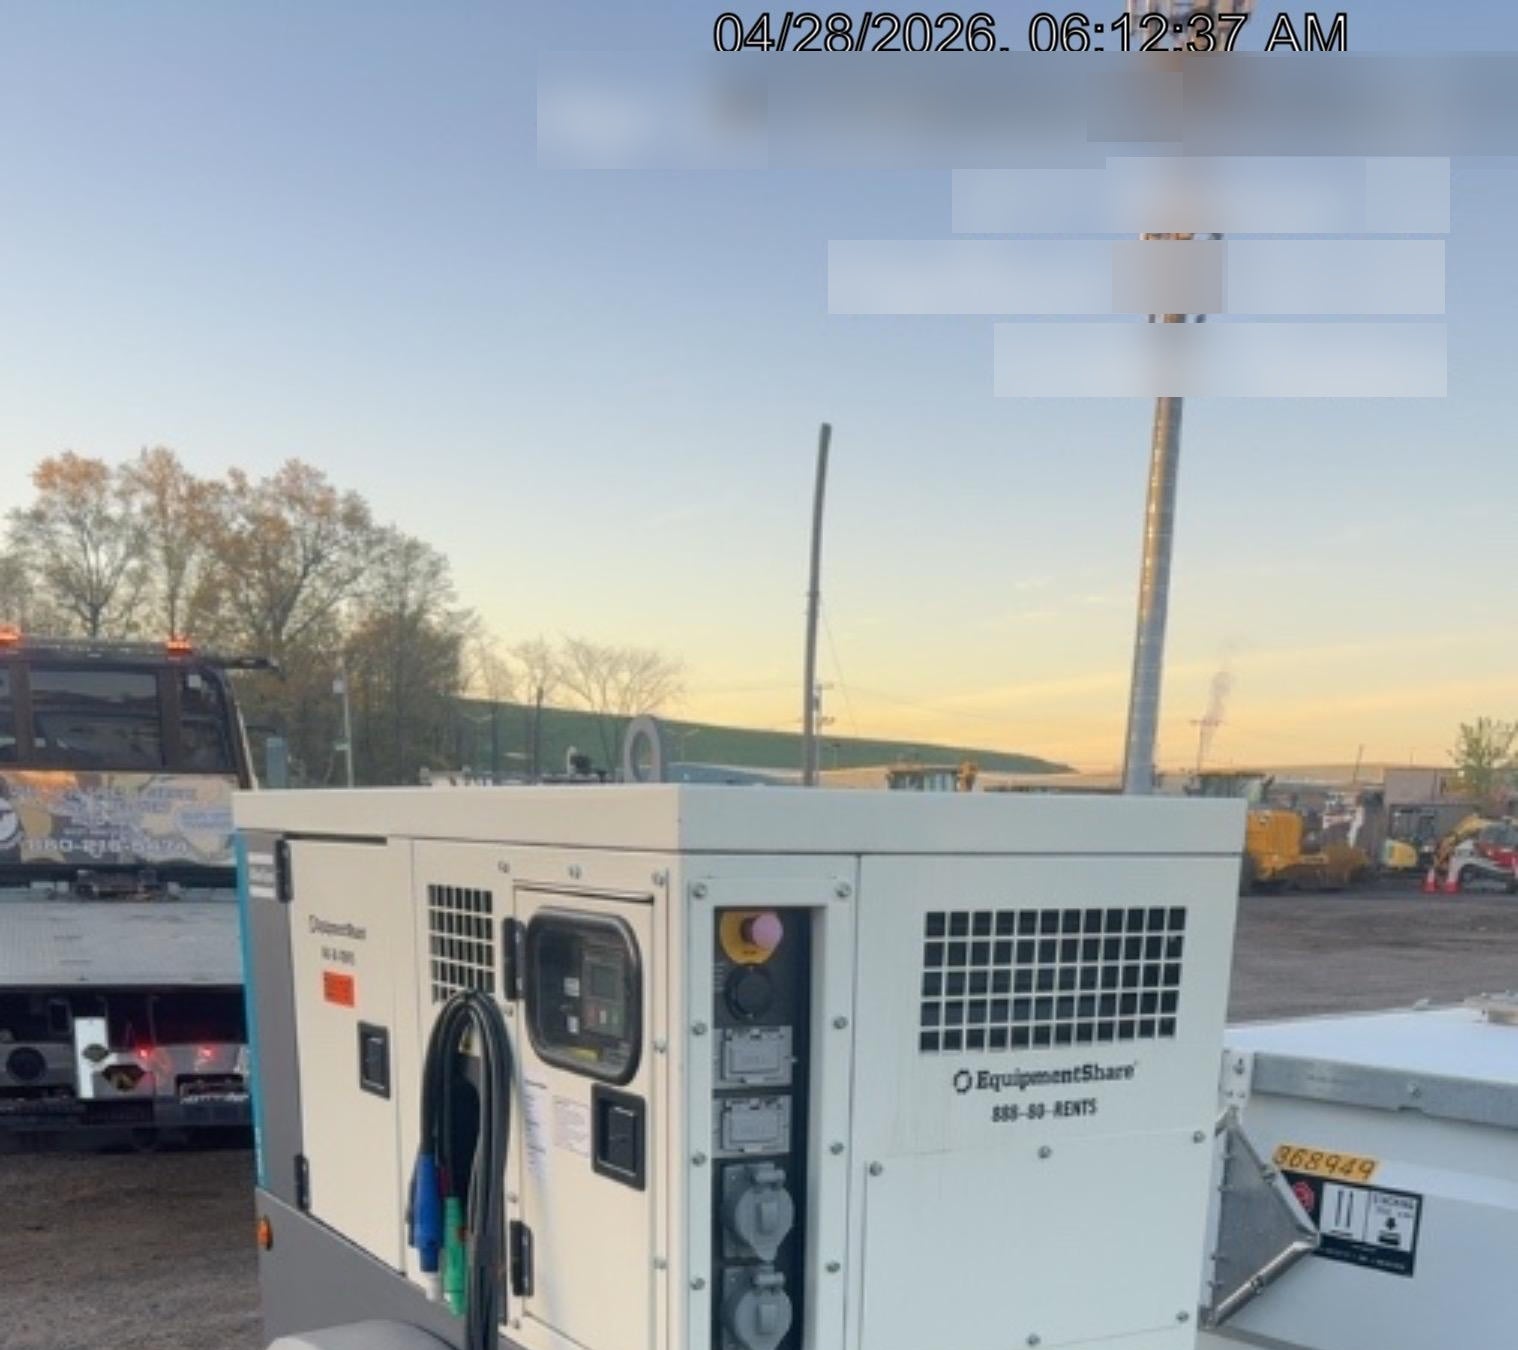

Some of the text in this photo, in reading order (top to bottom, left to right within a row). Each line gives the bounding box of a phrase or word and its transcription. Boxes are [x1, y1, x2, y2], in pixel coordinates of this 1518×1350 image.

[976, 1064, 1135, 1092] EquipmentShare
[992, 1098, 1097, 1123] 888-80-RENTS
[1272, 1145, 1376, 1180] 368949
